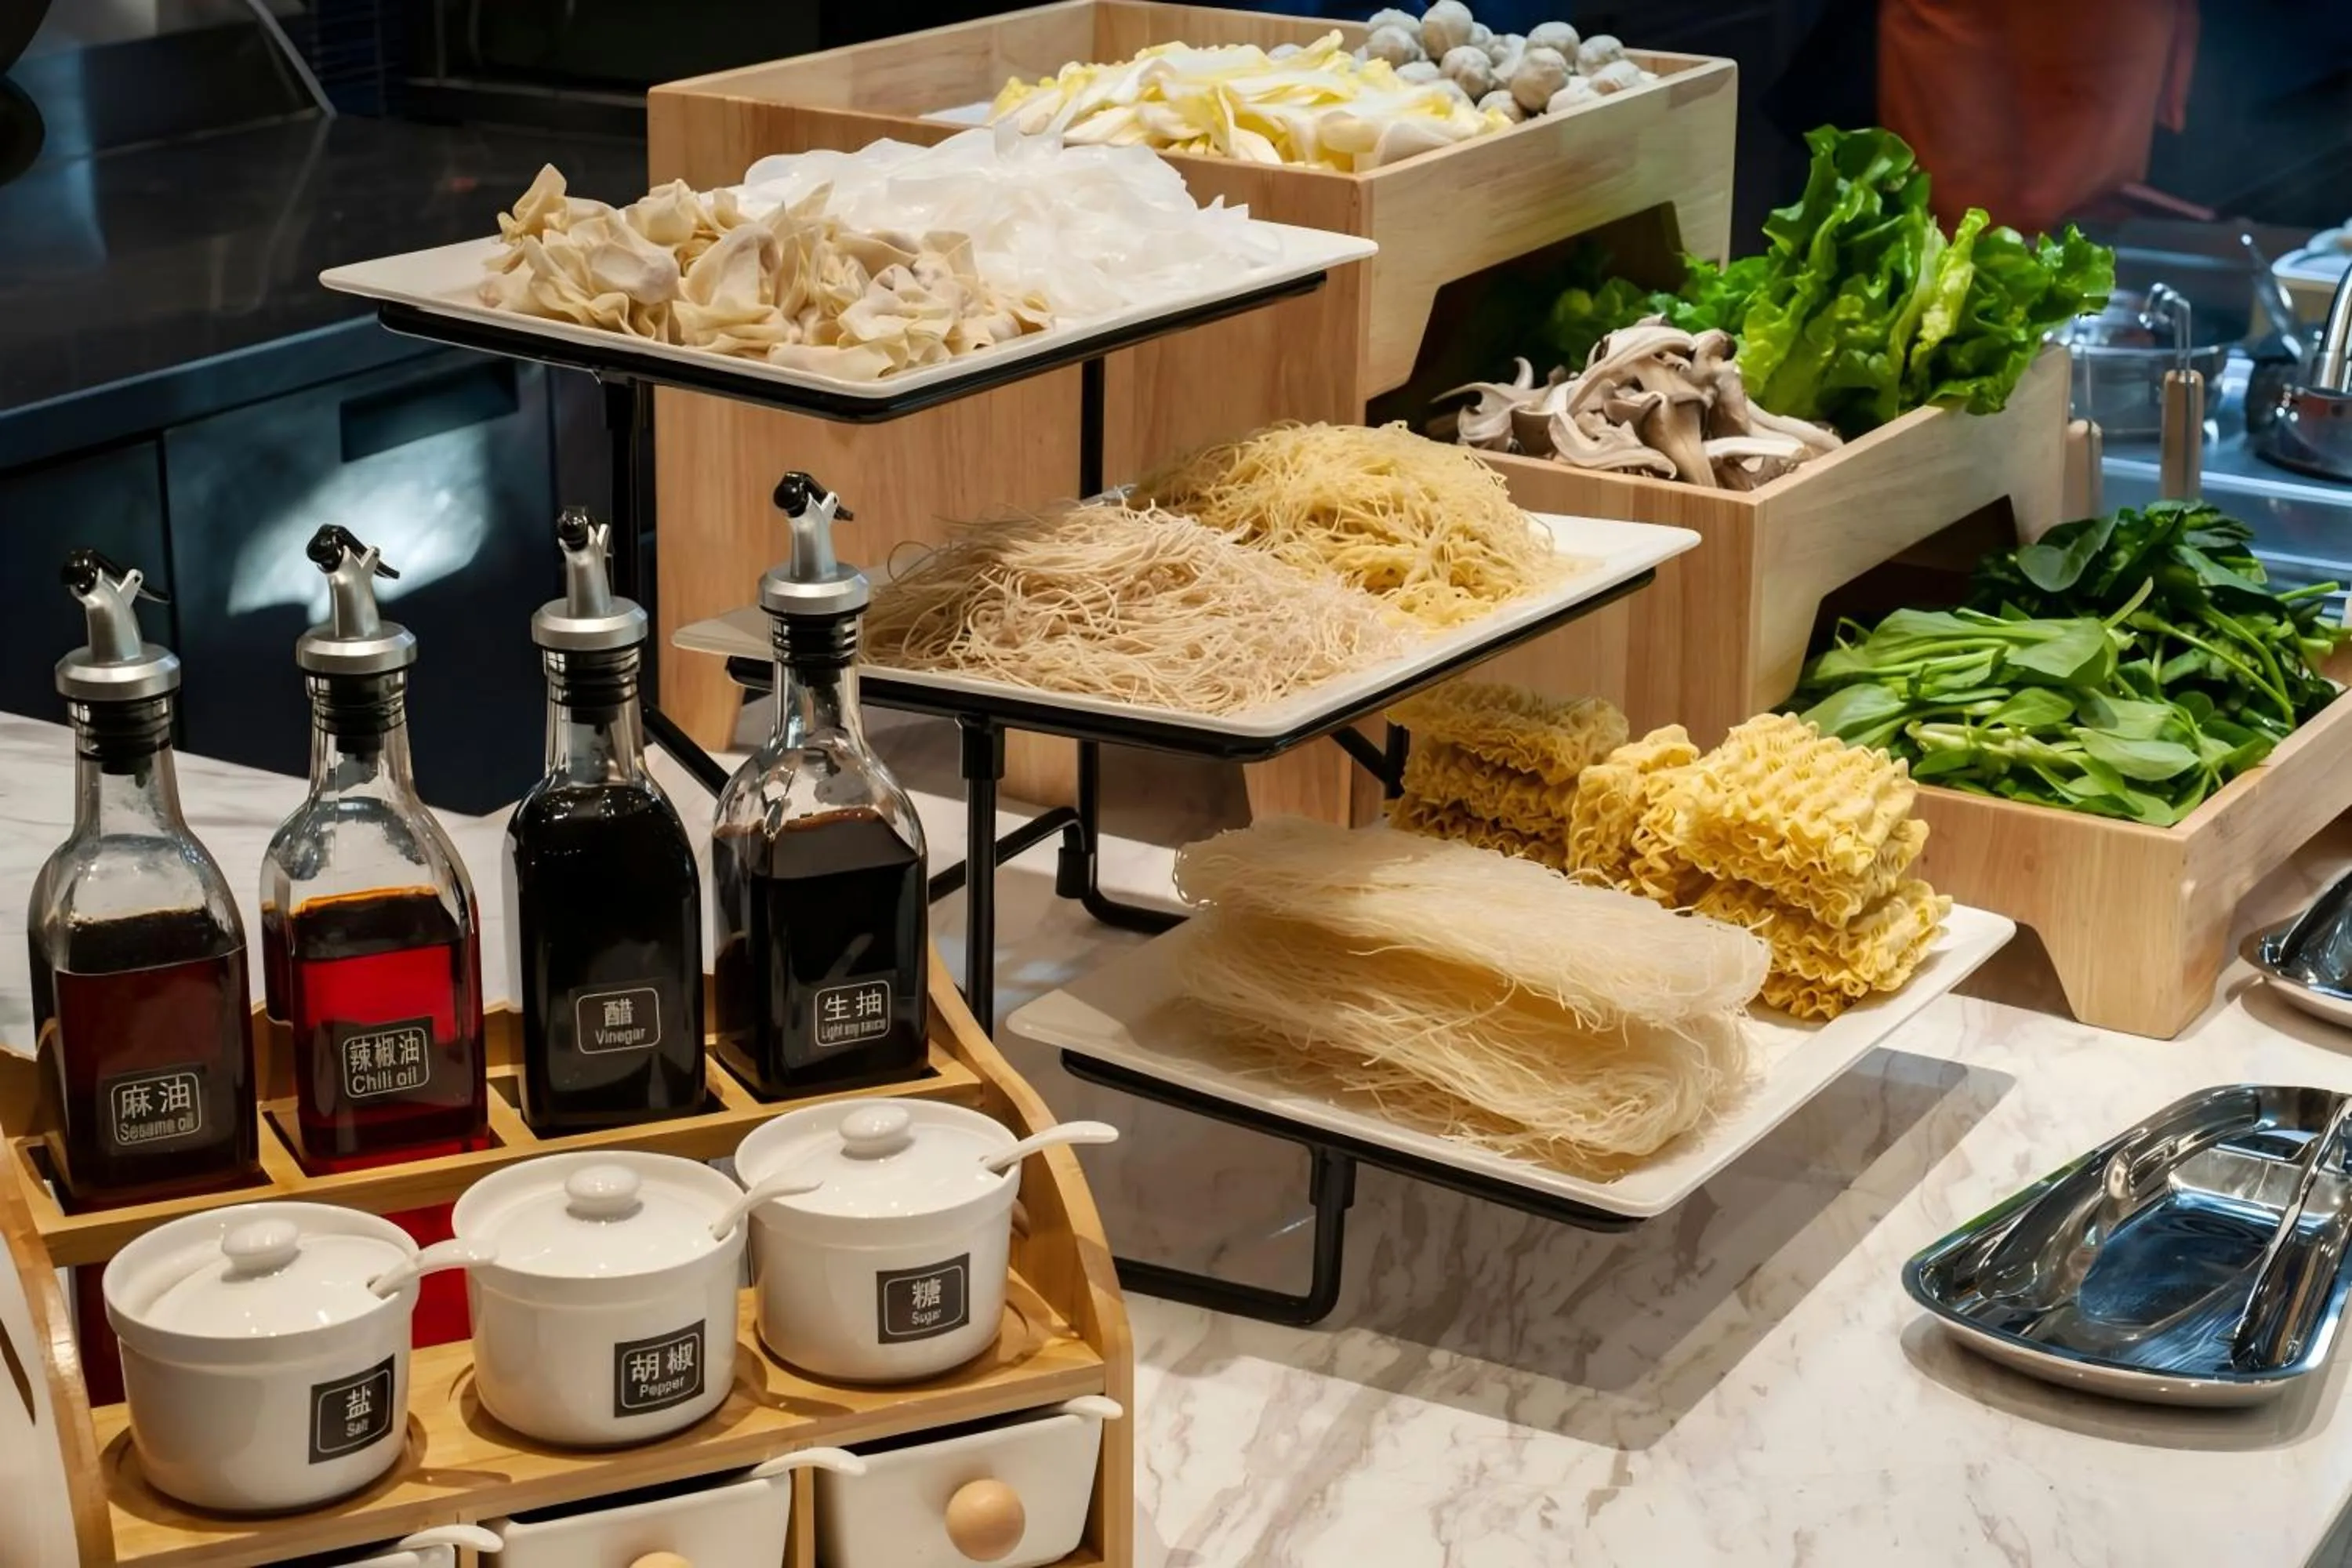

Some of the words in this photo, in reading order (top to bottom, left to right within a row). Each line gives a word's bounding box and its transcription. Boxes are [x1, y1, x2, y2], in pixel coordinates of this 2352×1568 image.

[602, 997, 633, 1027] 醋
[824, 989, 882, 1022] 生抽
[349, 1031, 419, 1073] 辣椒油
[595, 1028, 646, 1046] Vinegar
[352, 1069, 392, 1094] Chili
[397, 1066, 417, 1086] oil
[121, 1076, 191, 1120] 麻油
[911, 1277, 942, 1310] 糖
[630, 1341, 695, 1382] 胡椒
[344, 1385, 372, 1421] 盐
[639, 1376, 684, 1398] Pepper
